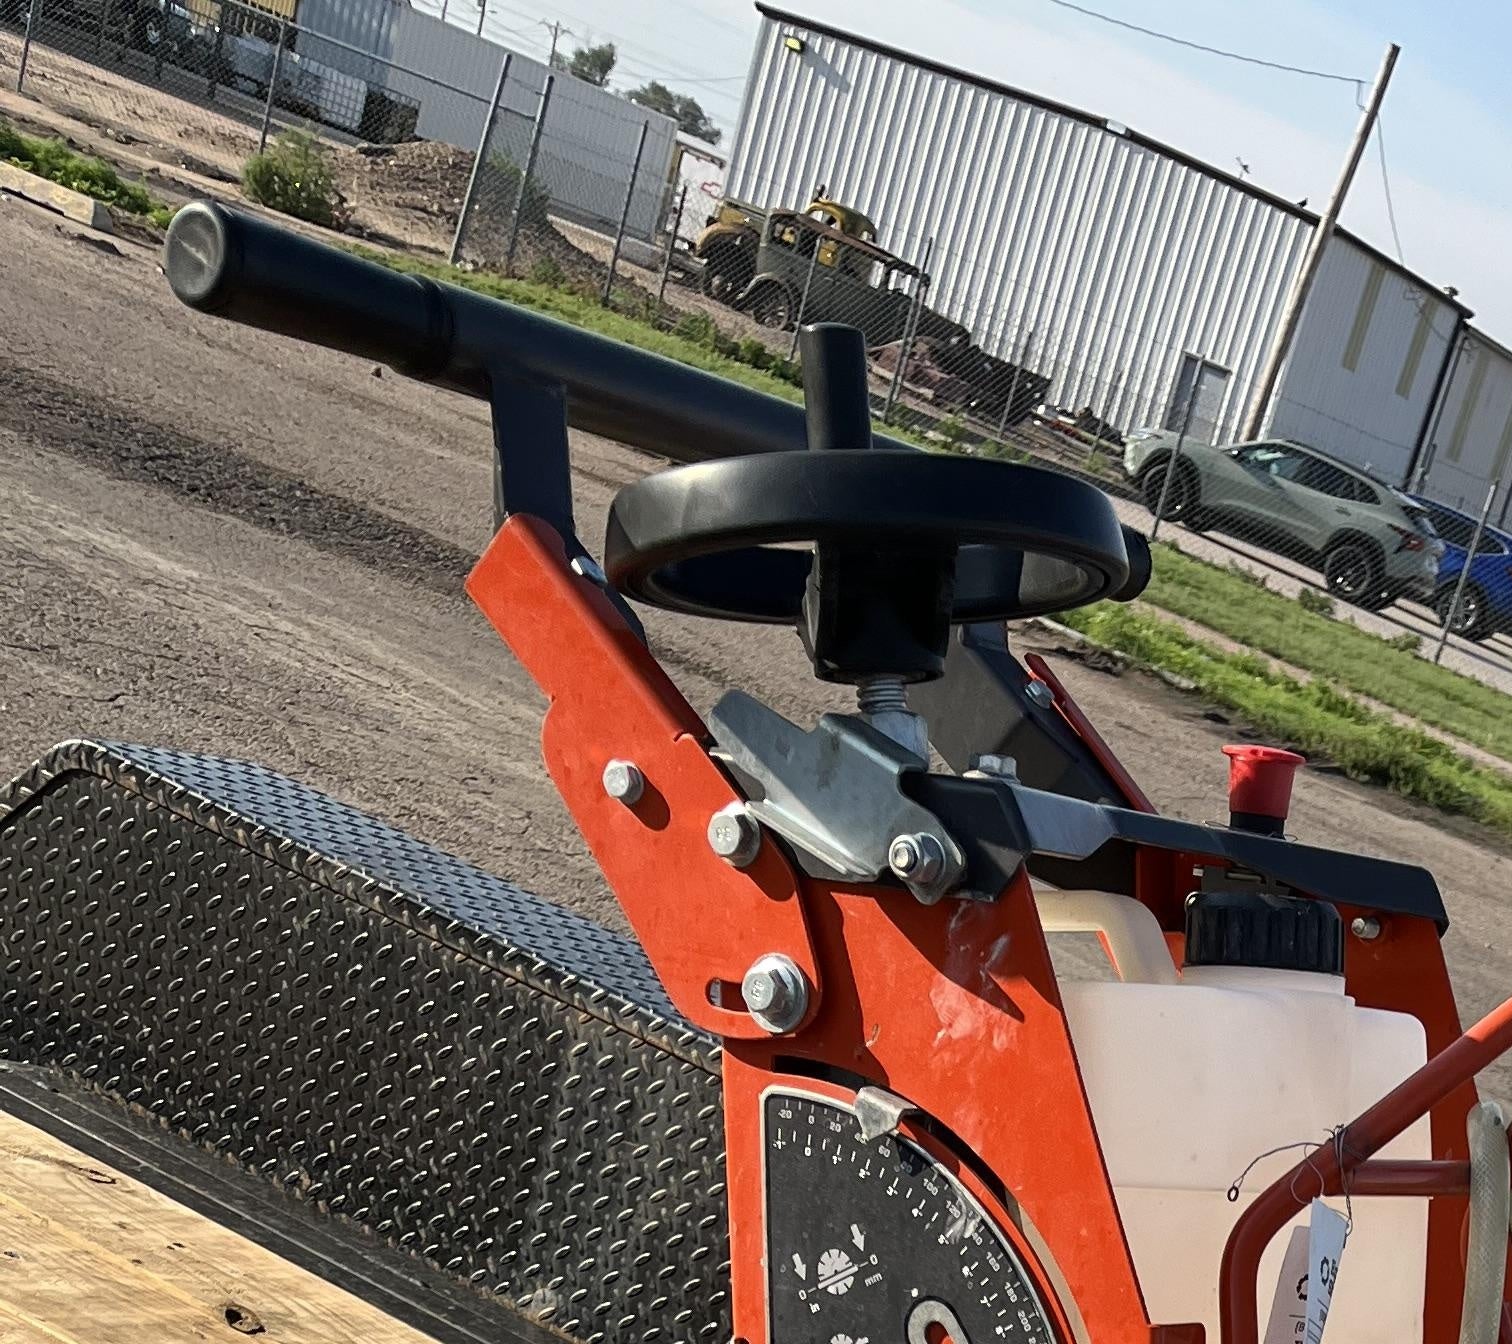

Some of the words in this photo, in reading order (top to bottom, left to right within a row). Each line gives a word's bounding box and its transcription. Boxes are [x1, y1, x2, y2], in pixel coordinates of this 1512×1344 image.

[805, 1147, 811, 1156] 0
[808, 1115, 815, 1124] 0
[829, 1122, 841, 1132] 20
[923, 1178, 938, 1196] 100
[1018, 1310, 1031, 1332] 200
[864, 1273, 882, 1287] mm
